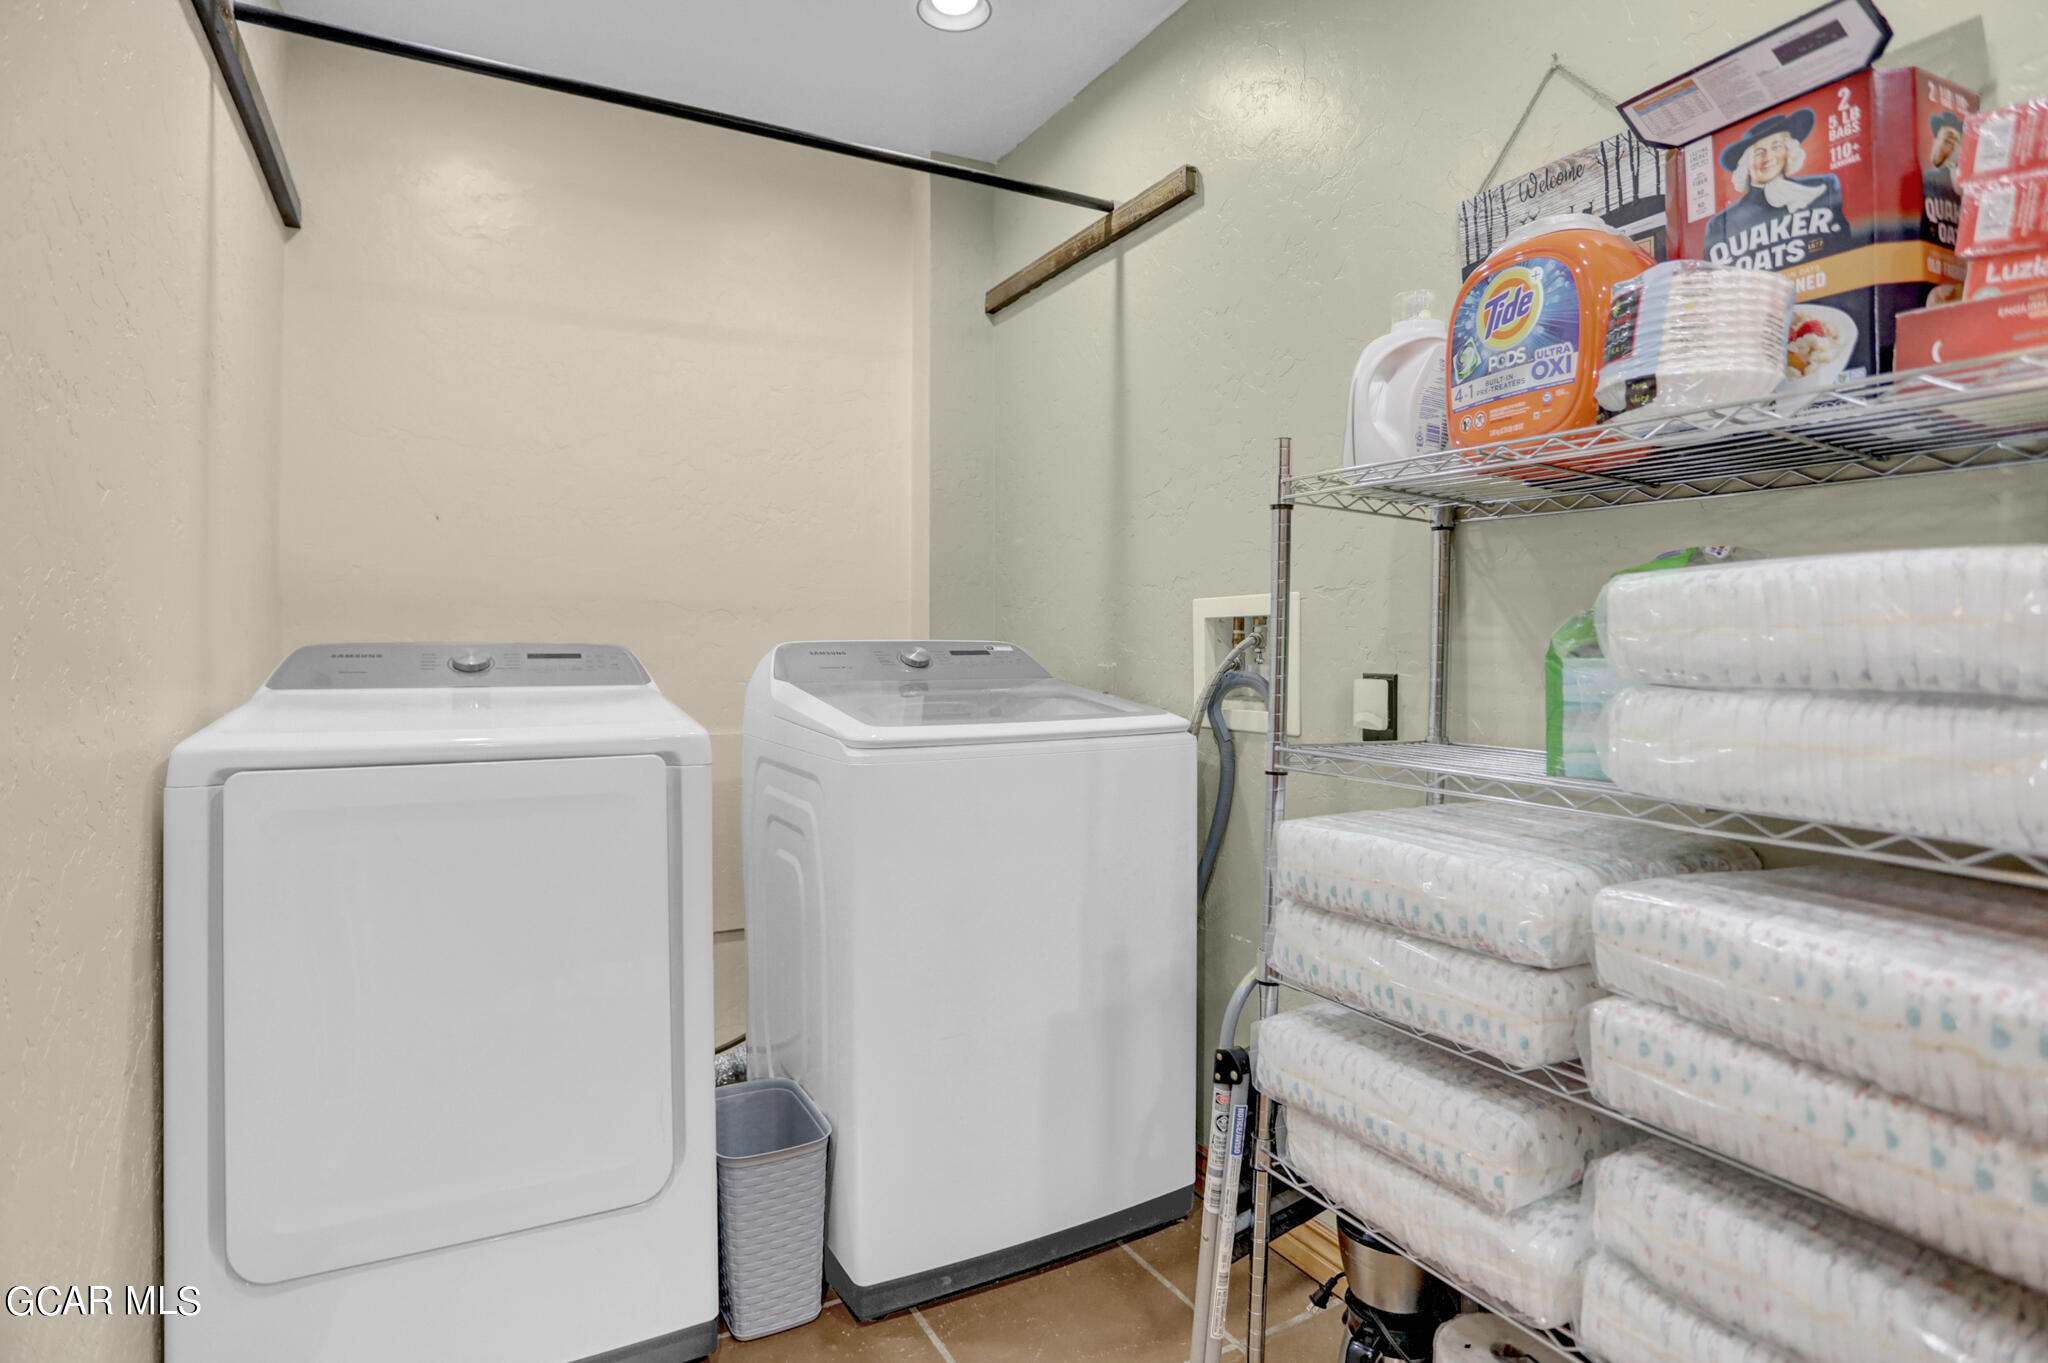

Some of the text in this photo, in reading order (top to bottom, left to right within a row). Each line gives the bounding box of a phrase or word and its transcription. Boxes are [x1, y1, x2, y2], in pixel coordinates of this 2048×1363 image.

[1837, 86, 1851, 111] 2
[1828, 105, 1862, 129] 5 LB
[1828, 120, 1862, 142] BAGS
[1829, 141, 1861, 163] 110+
[1519, 163, 1586, 202] Welcome
[1735, 238, 1806, 272] OATS
[1484, 283, 1535, 340] Tide
[1488, 344, 1573, 373] PODS ULTRA
[1531, 354, 1572, 381] OXI
[1476, 377, 1527, 397] PRE-TREATERS
[1484, 373, 1514, 387] BUILT-IN
